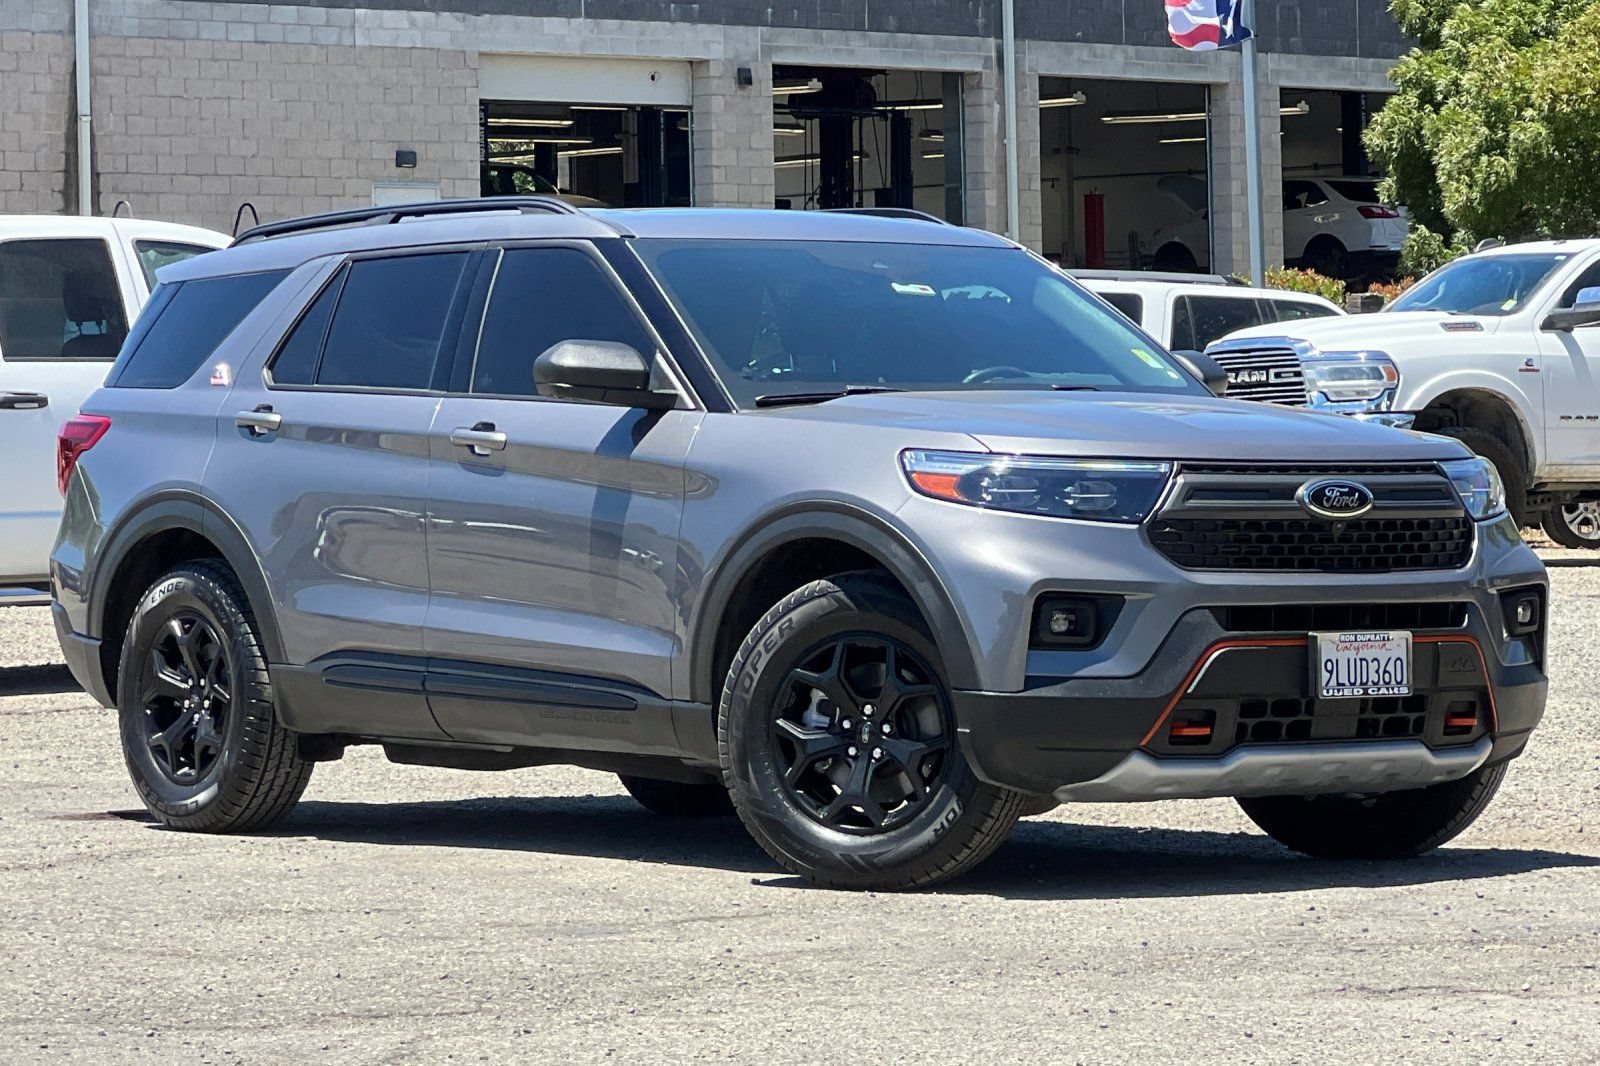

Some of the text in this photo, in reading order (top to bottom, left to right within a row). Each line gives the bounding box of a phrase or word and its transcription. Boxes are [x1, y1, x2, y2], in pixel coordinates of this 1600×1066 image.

[1323, 486, 1360, 507] Ford
[1340, 632, 1389, 642] RON DUPRATT
[1336, 642, 1392, 655] California
[1324, 657, 1404, 687] 9LUD360
[1322, 686, 1409, 697] USED CARS
